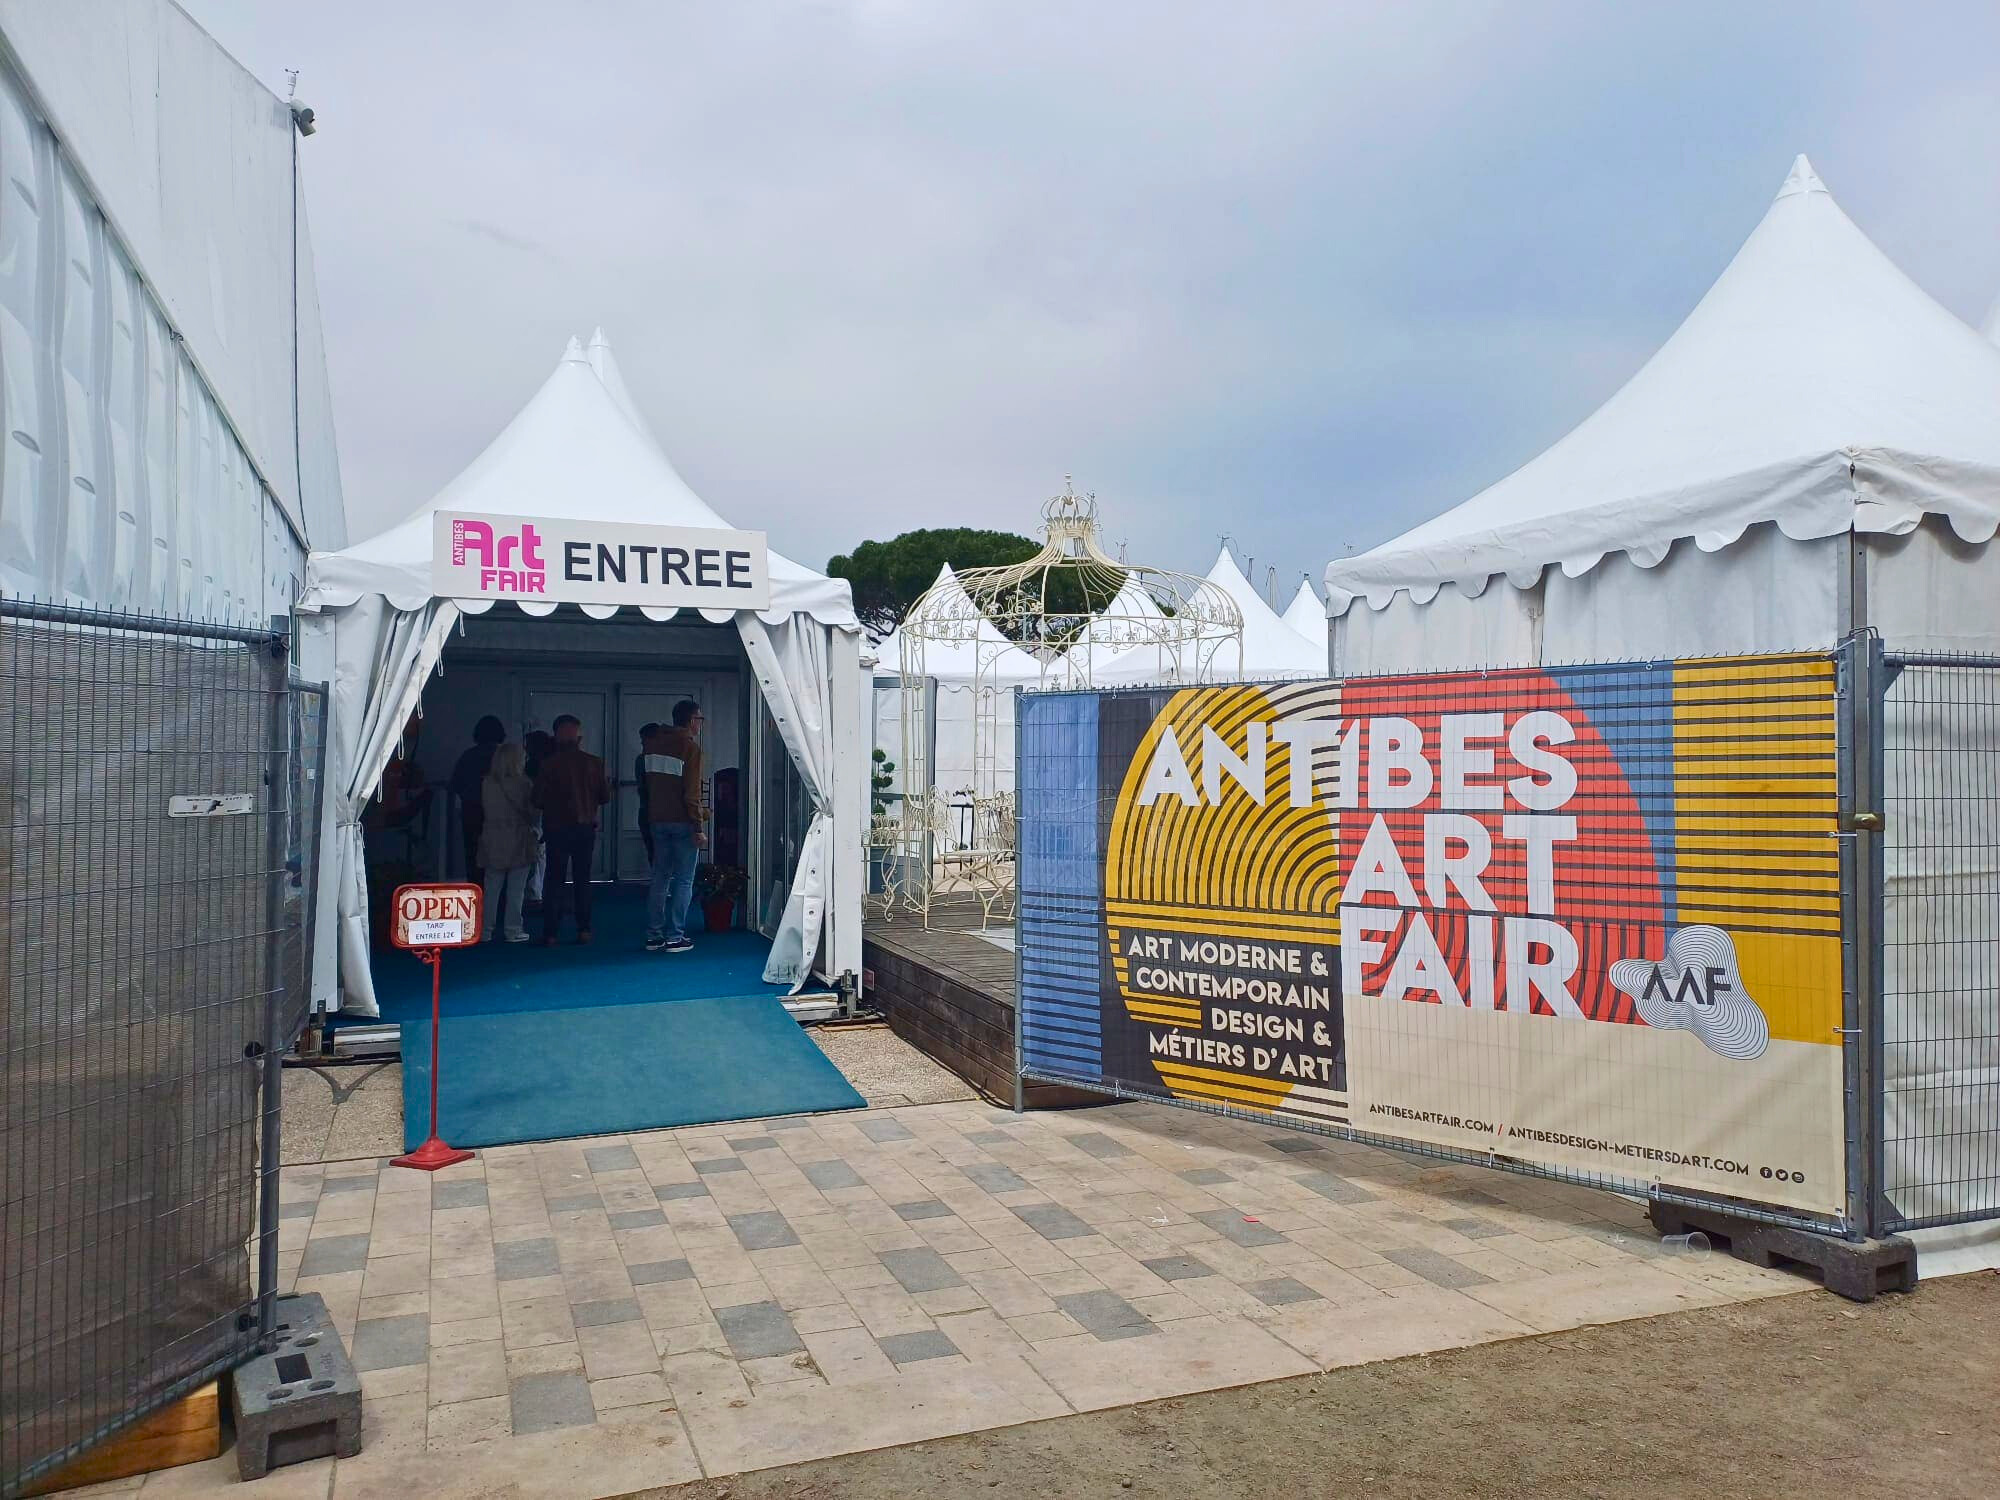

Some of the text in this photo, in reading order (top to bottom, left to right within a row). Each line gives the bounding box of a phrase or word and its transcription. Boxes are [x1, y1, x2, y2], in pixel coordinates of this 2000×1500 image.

[453, 520, 544, 569] Art
[454, 522, 464, 564] ANTIBES
[564, 541, 752, 588] ENTREE
[481, 570, 545, 593] FAIR
[1139, 711, 1577, 810] ANTIBES
[1341, 813, 1577, 915] ART
[401, 897, 473, 920] OPEN
[1128, 935, 1328, 976] ART MODERNE &
[1340, 906, 1587, 1020] FAIR
[1136, 967, 1329, 1011] CONTEMPORAIN
[1150, 1028, 1245, 1067] MÉTIERS
[1211, 1007, 1331, 1047] DESIGN &
[1369, 1103, 1494, 1134] ANTIBESARTFAIR.COM
[1508, 1126, 1749, 1176] ANTIBESDESIGN-METIERSDART.COM
